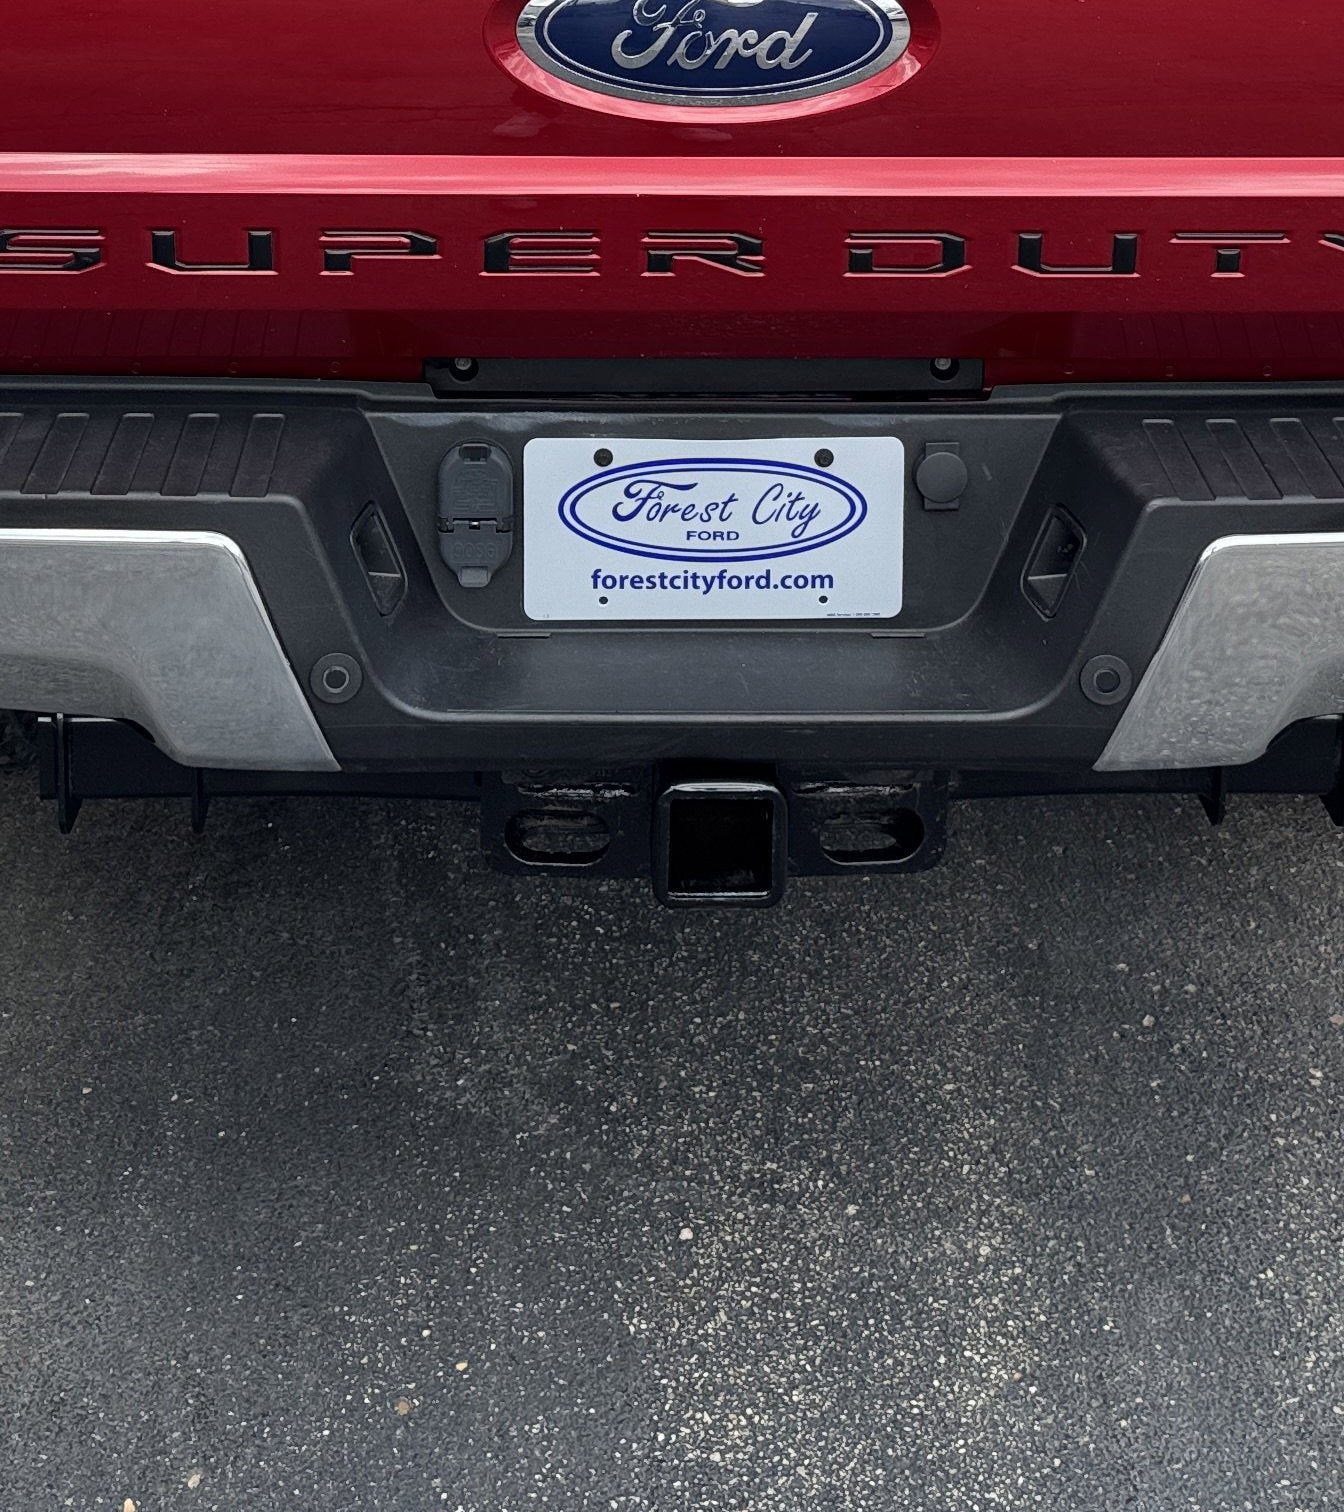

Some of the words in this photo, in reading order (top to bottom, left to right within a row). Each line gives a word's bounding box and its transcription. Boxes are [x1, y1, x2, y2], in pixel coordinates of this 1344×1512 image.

[612, 479, 739, 522] Forest
[751, 482, 821, 539] City
[686, 530, 740, 541] FORD
[591, 568, 835, 595] forestcityford.com
